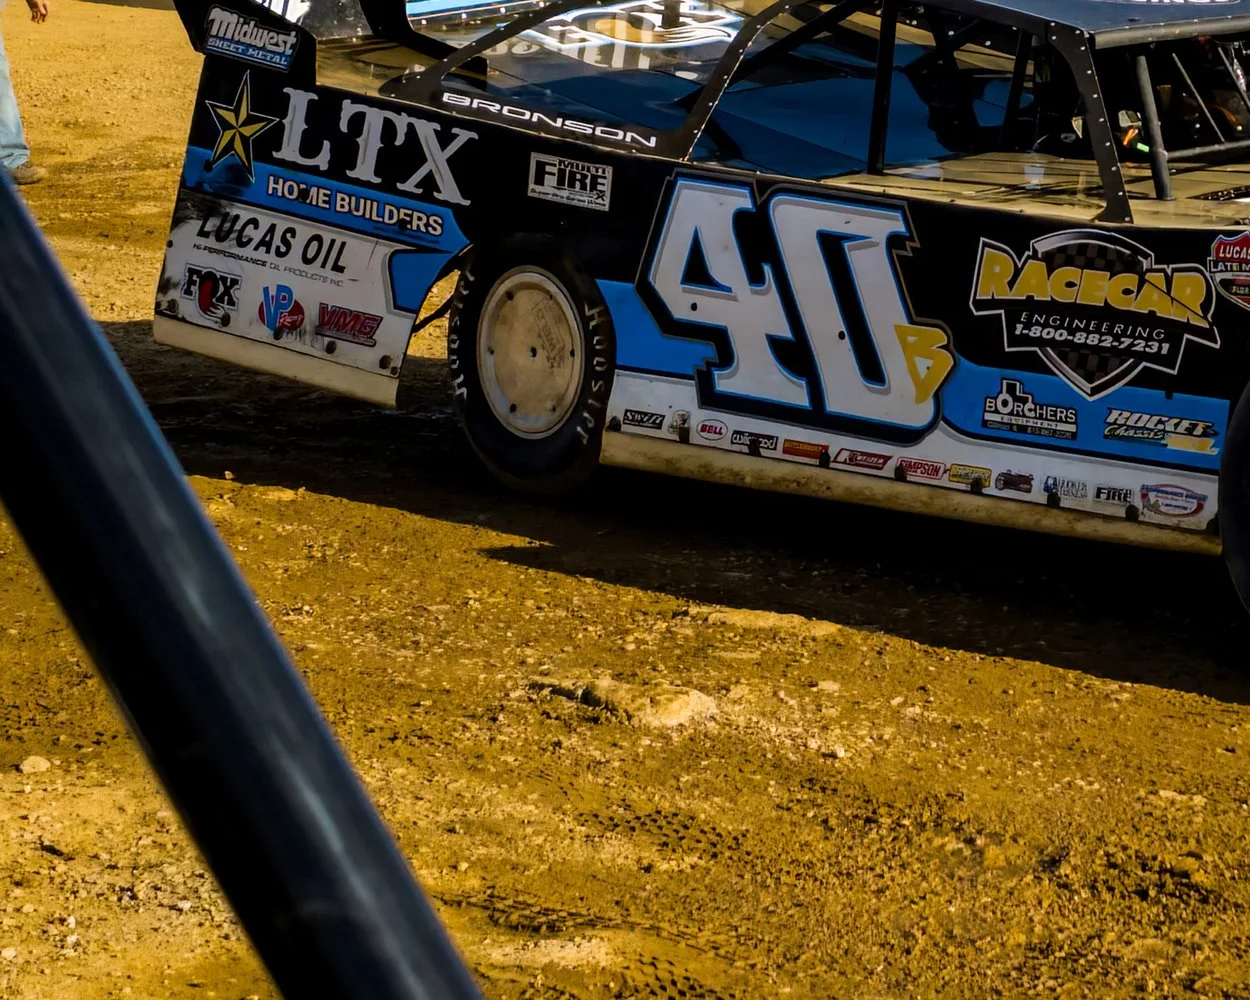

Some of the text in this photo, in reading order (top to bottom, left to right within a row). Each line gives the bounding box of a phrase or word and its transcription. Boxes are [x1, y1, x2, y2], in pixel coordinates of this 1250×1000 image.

[207, 4, 298, 56] Midwest
[207, 37, 288, 66] SHEET METAL
[443, 92, 656, 148] BRONSON
[272, 86, 479, 206] LTX
[534, 160, 608, 193] FIRE
[336, 193, 443, 236] BUILDERS
[196, 210, 347, 274] LUCAS OIL
[1210, 260, 1240, 273] LATE
[975, 246, 1209, 329] RACECAR
[1014, 323, 1170, 355] 1-800-882-7231
[1021, 312, 1165, 340] ENGINEERING
[985, 392, 1077, 424] BORCHERS
[1105, 408, 1214, 436] ROCKET
[699, 423, 724, 436] BELL
[1104, 424, 1164, 440] Chassis
[899, 459, 941, 477] SIMPSON
